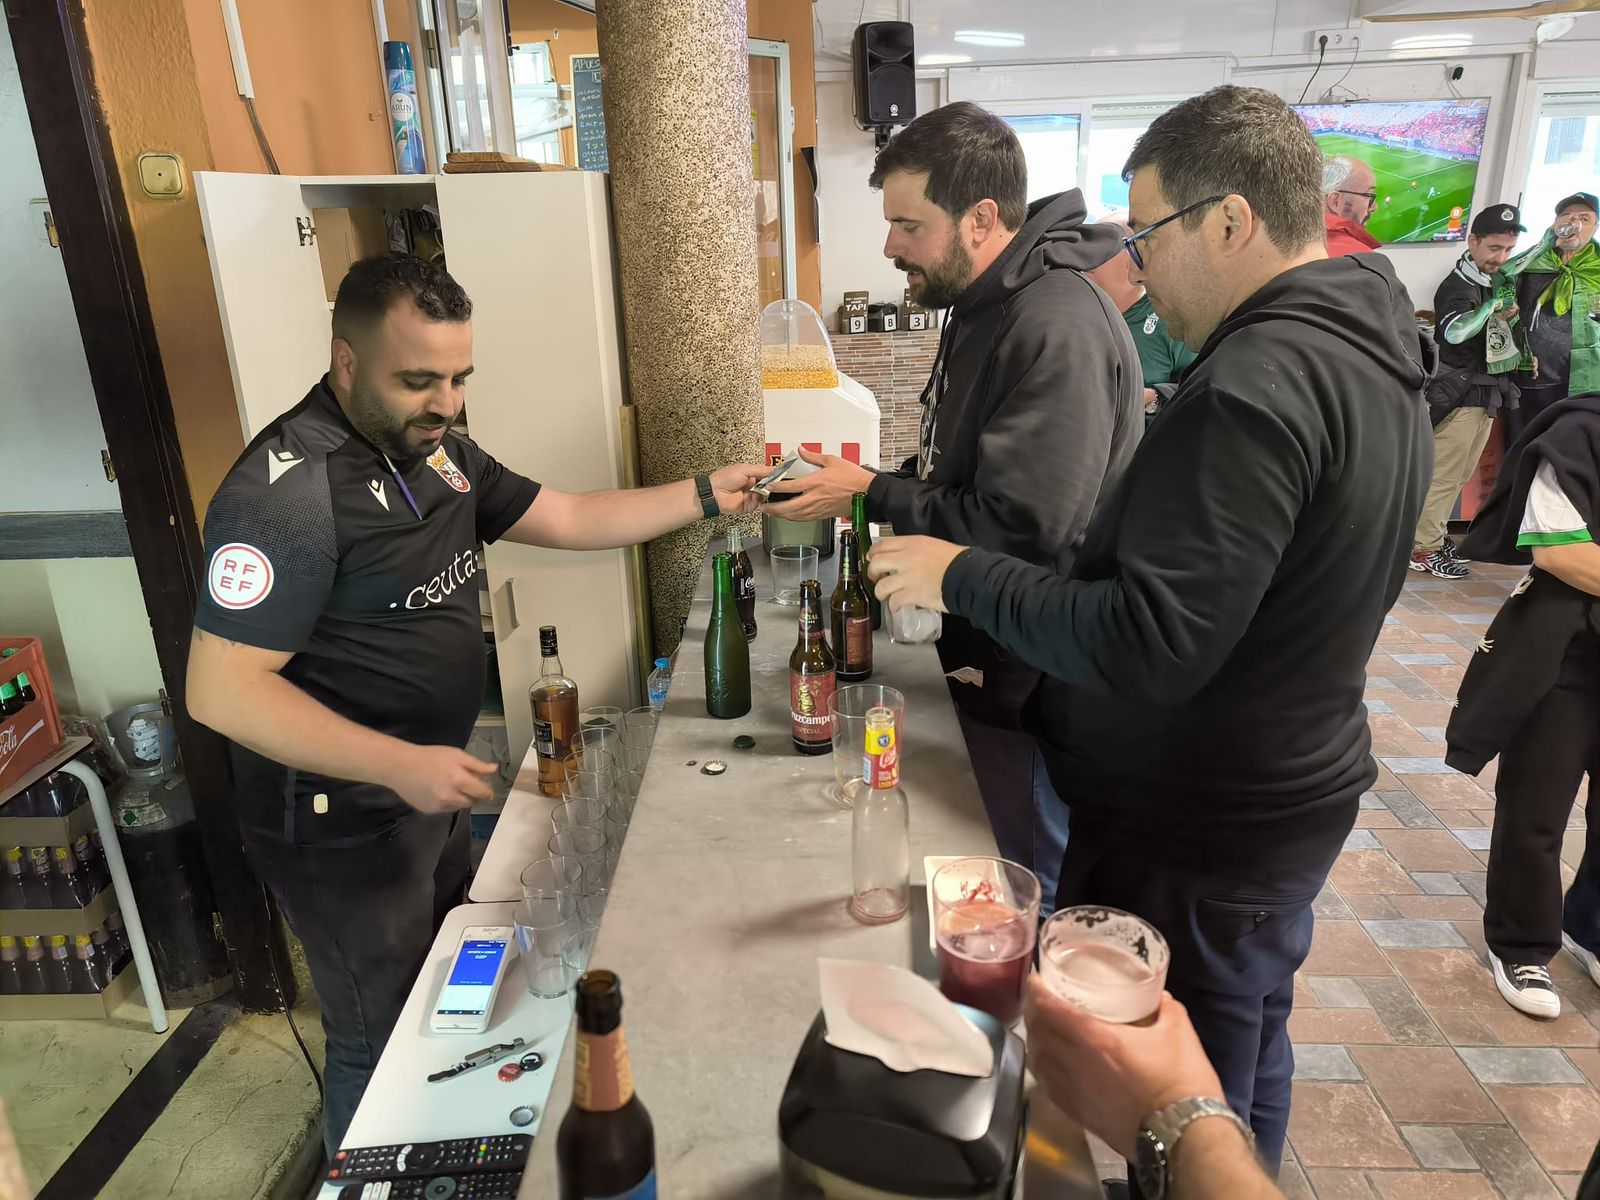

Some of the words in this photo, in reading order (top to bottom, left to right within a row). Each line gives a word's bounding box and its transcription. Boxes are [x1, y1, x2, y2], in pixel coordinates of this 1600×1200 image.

[854, 319, 861, 330] 9
[913, 317, 921, 328] 3
[791, 711, 837, 727] ruzcampo
